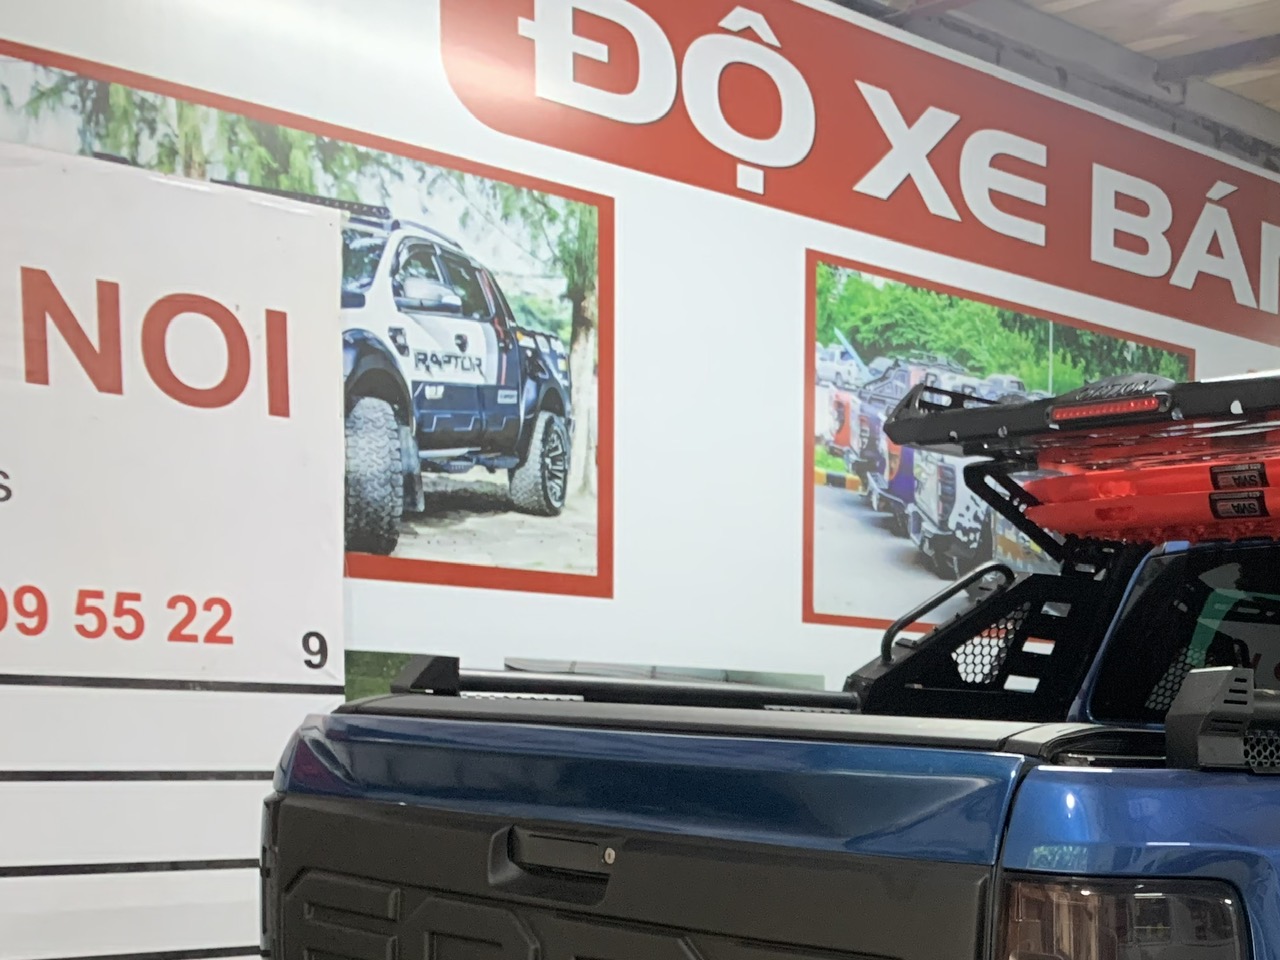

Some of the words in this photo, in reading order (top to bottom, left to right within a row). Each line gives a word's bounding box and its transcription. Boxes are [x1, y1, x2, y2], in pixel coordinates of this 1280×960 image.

[518, 0, 816, 195] ĐỘ
[853, 80, 1048, 247] XE
[414, 351, 487, 381] RAPTOR
[0, 584, 48, 636] 9
[74, 589, 145, 641] 55
[166, 594, 234, 645] 22
[301, 631, 328, 670] 9
